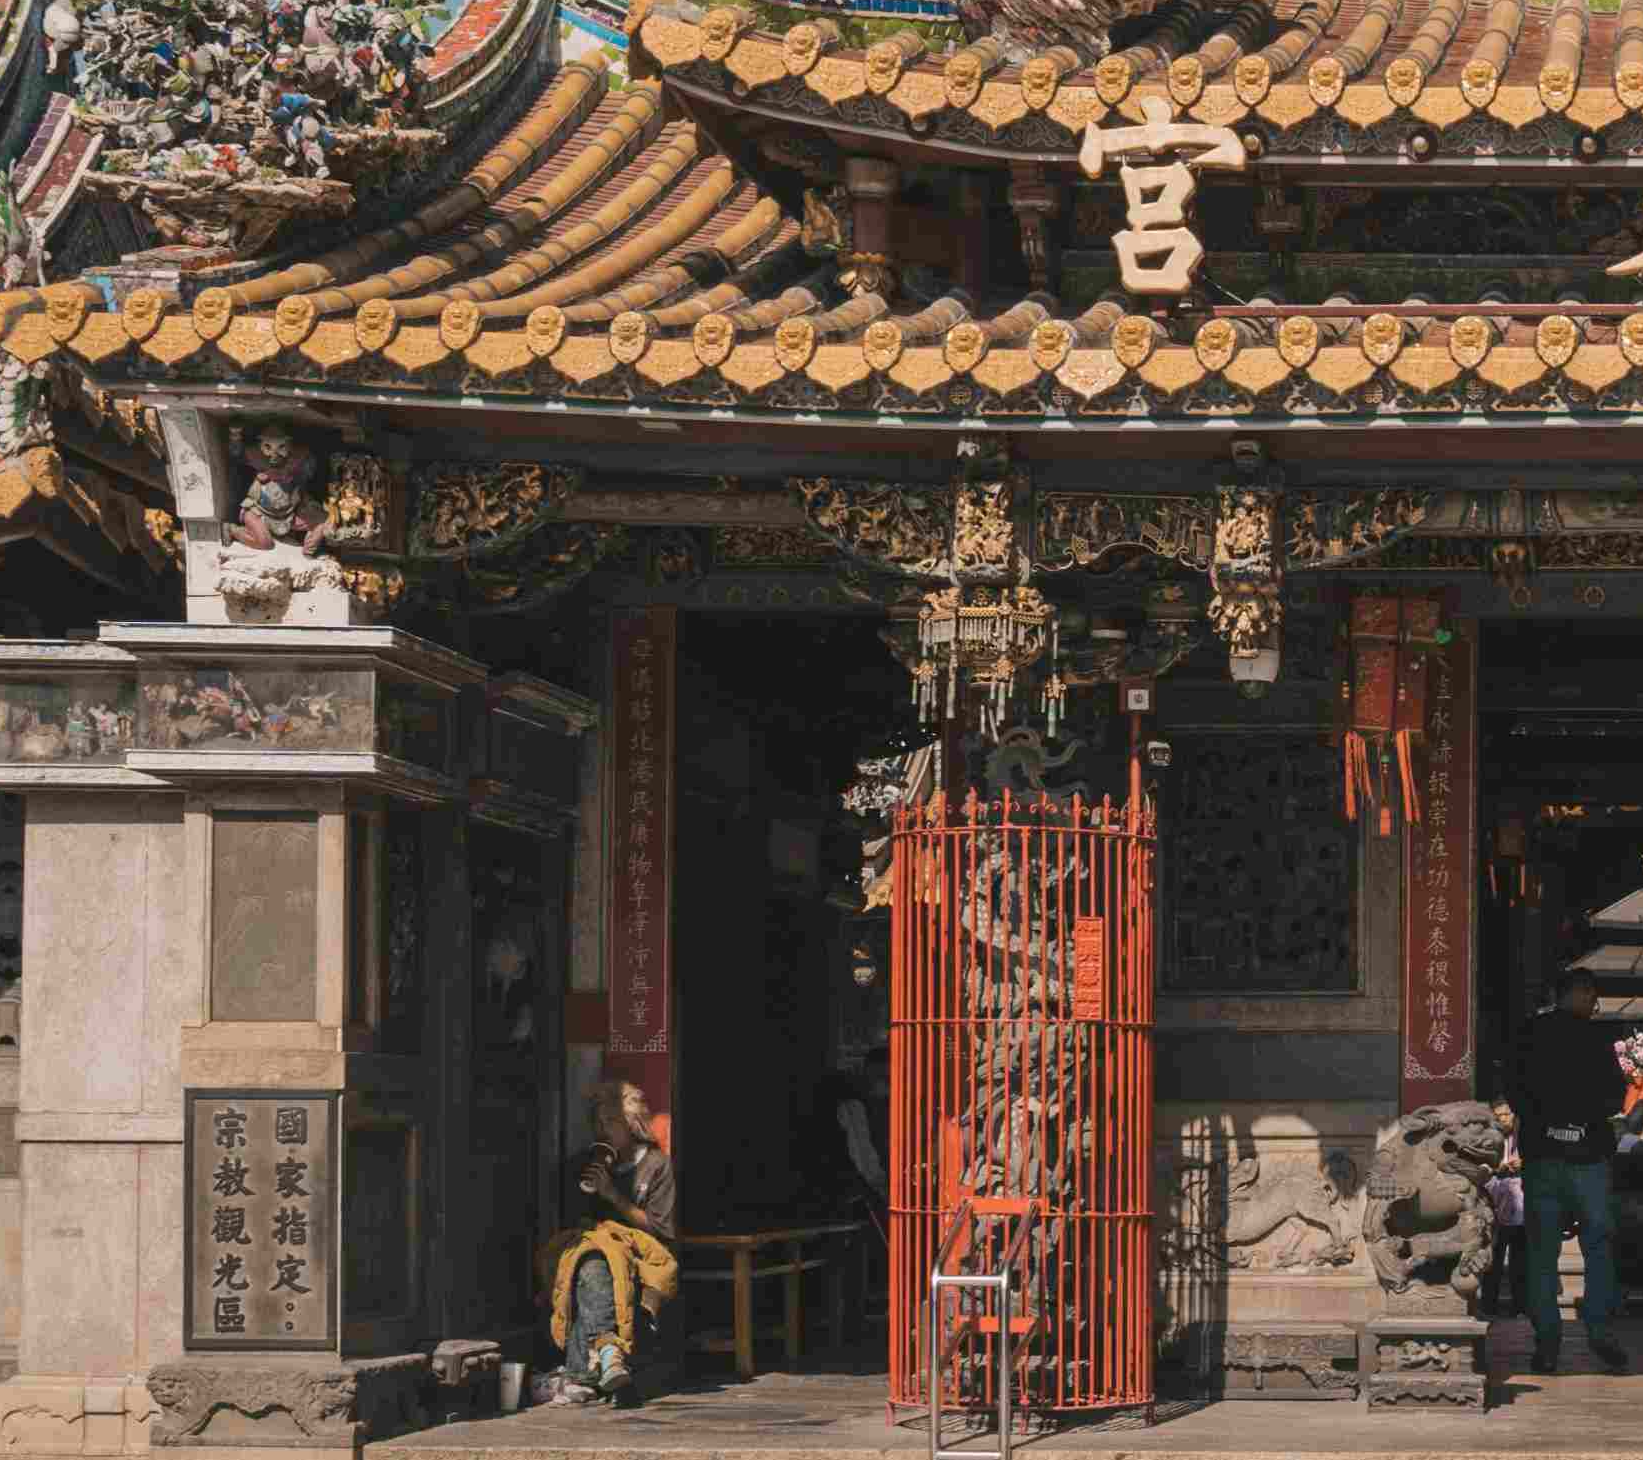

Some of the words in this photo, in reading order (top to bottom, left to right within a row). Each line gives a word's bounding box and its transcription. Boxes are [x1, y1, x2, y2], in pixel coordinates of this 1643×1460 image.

[211, 1106, 257, 1334] 宗教觀光區
